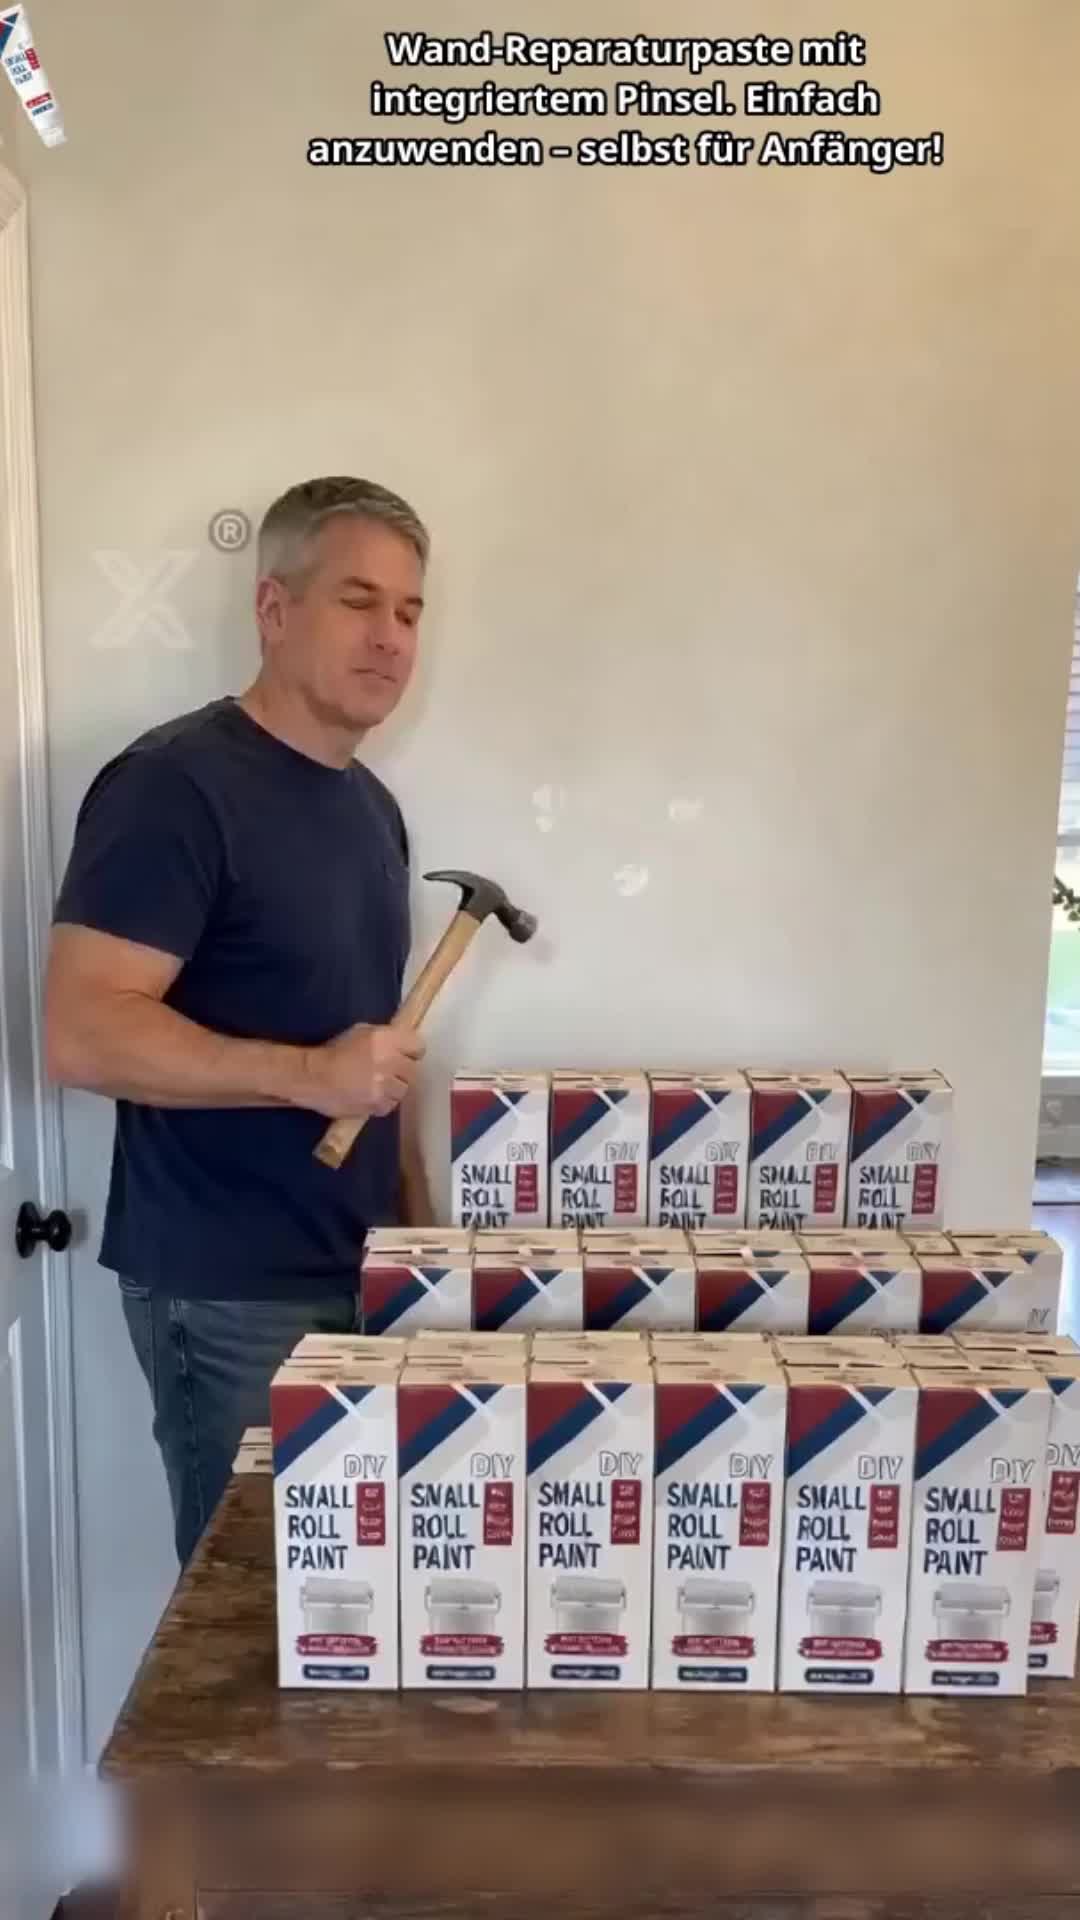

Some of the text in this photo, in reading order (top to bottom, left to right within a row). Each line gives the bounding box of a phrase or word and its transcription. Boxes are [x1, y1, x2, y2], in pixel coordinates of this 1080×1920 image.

[344, 1454, 387, 1479] DIY
[470, 1453, 515, 1478] DIY
[599, 1451, 643, 1476] DIY
[729, 1453, 774, 1478] DIY
[858, 1455, 903, 1480] DIY
[990, 1457, 1036, 1484] DIY
[538, 1481, 606, 1507] SMALL
[288, 1515, 341, 1539] ROLL
[412, 1514, 467, 1539] ROLL
[539, 1512, 592, 1537] ROLL
[667, 1514, 723, 1539] ROLL
[797, 1515, 851, 1541] ROLL
[925, 1518, 980, 1544] ROLL
[287, 1545, 348, 1570] PAINT
[413, 1545, 476, 1570] PAINT
[539, 1543, 601, 1569] PAINT
[667, 1544, 731, 1570] PAINT
[795, 1547, 857, 1573] PAINT
[923, 1549, 988, 1575] PAINT
